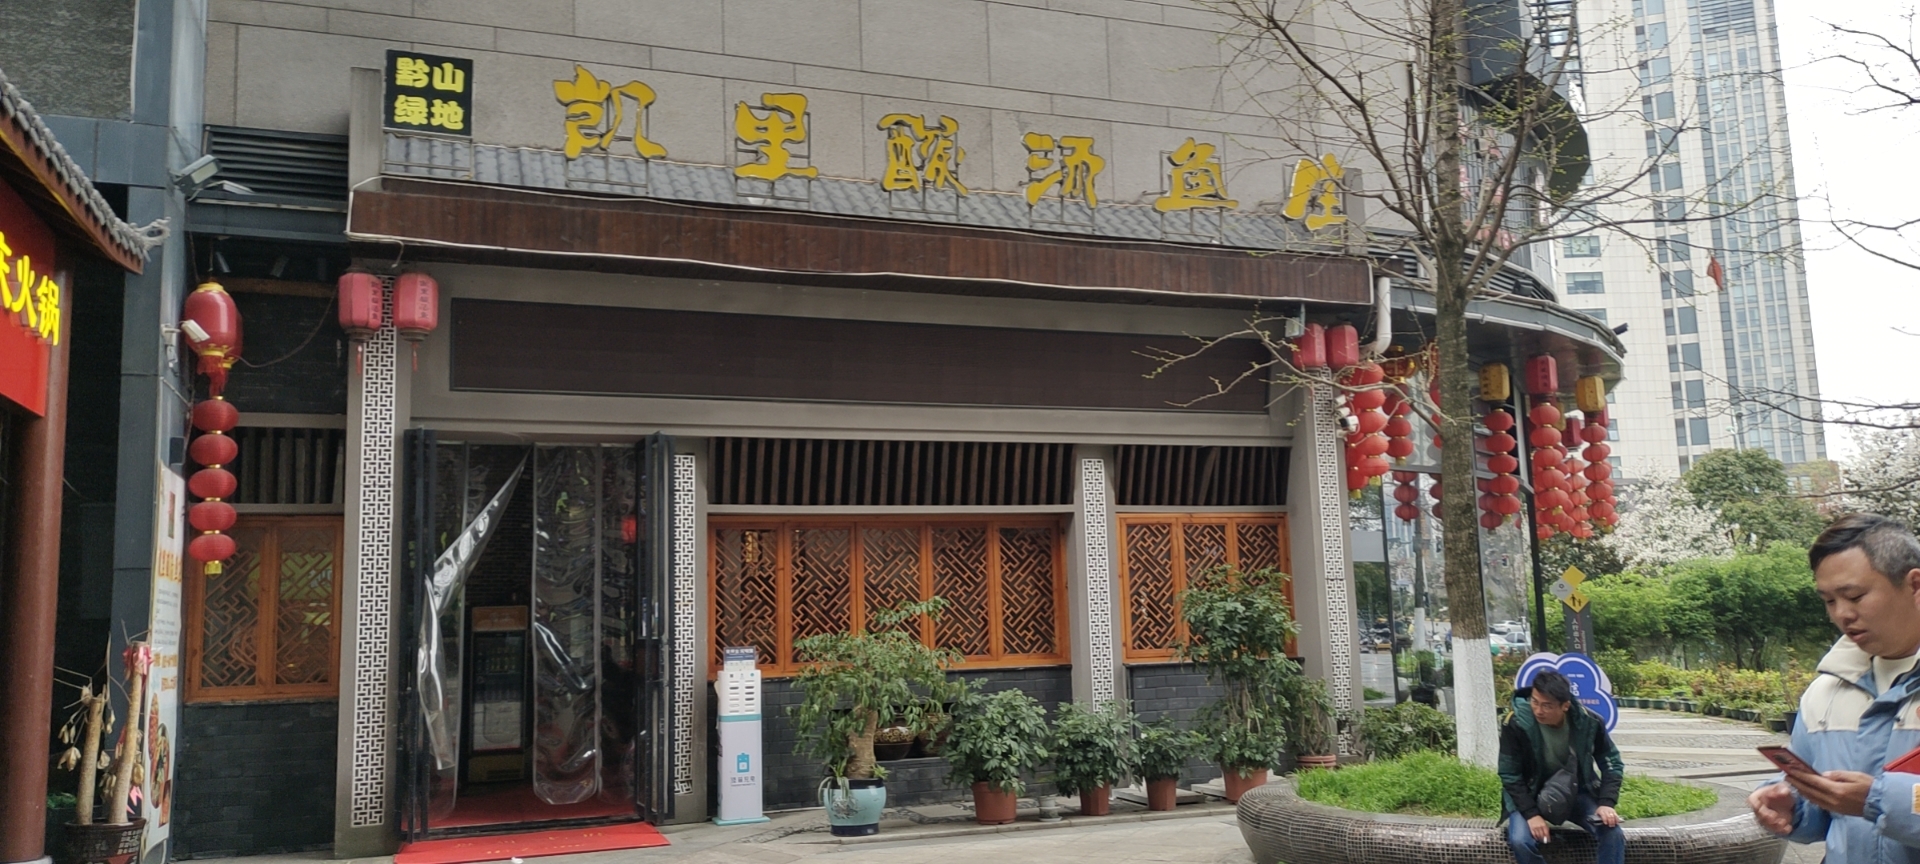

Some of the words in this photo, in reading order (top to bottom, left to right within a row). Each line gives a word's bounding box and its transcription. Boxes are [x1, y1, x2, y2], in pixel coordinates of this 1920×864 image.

[395, 57, 465, 93] 黔山
[394, 95, 464, 130] 绿地
[1571, 618, 1582, 650] 人行出入口
